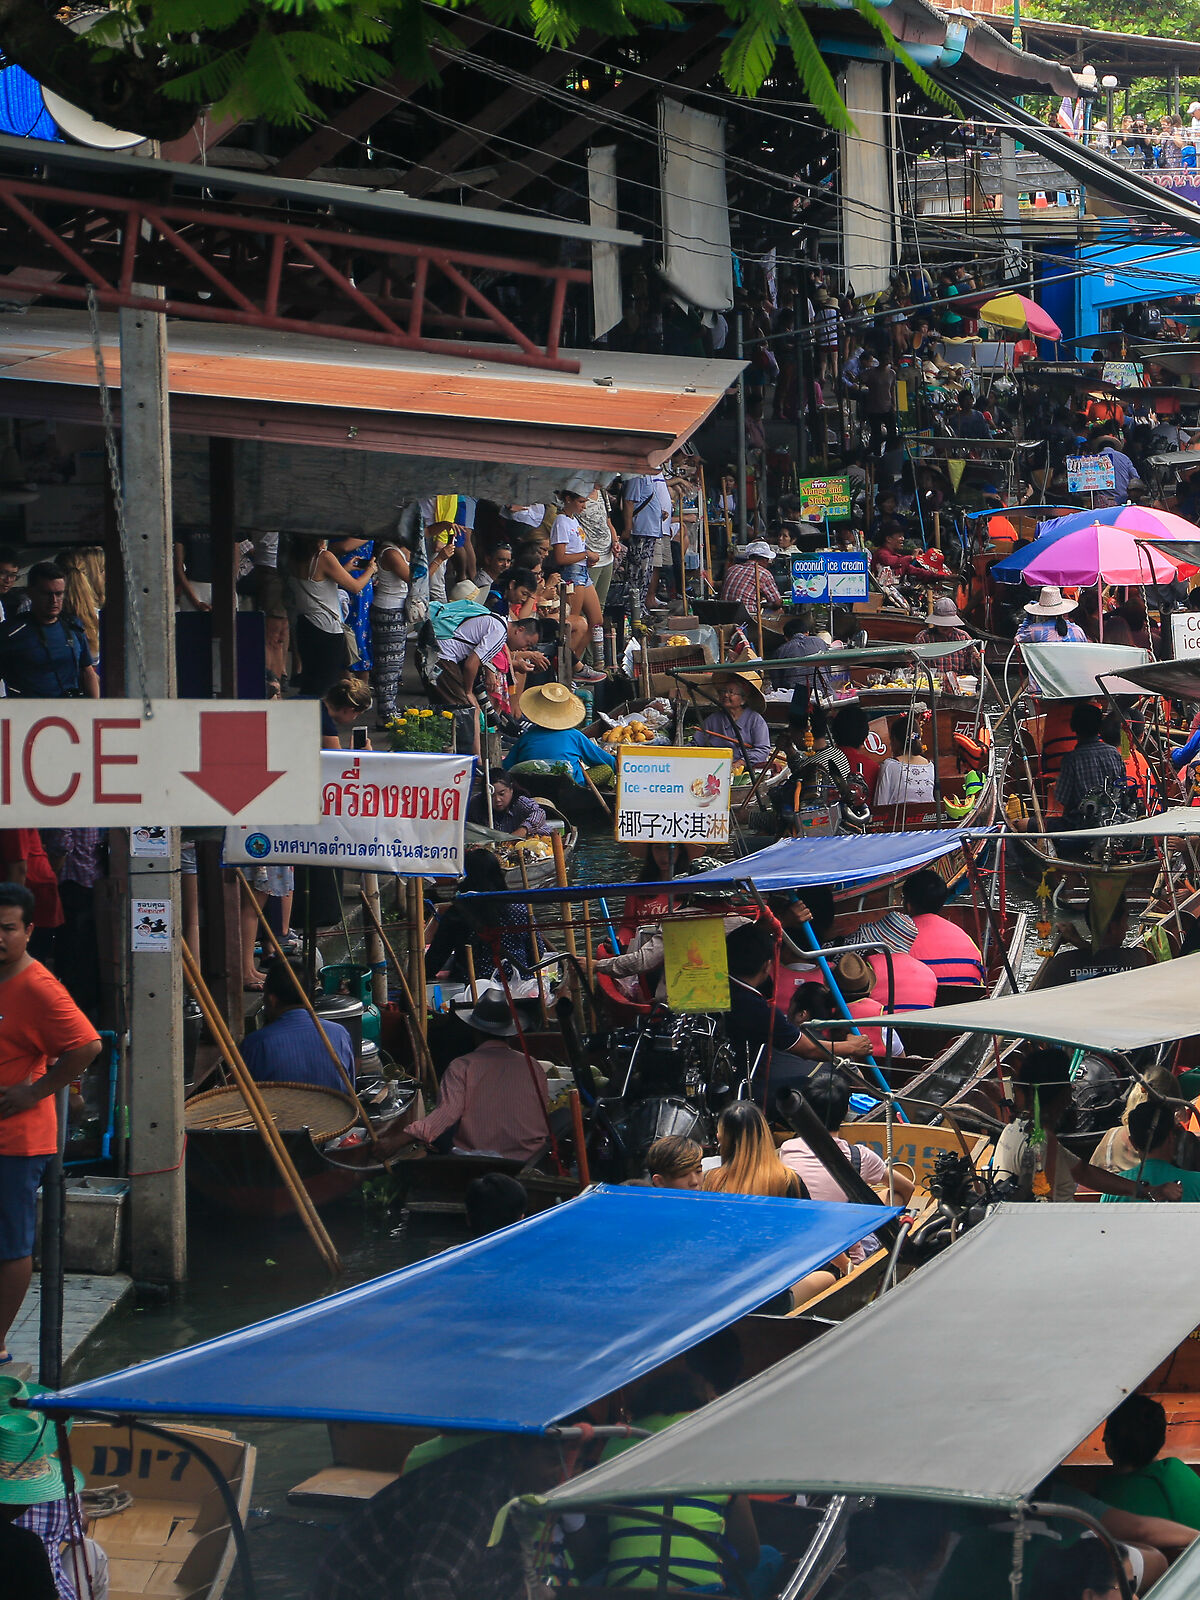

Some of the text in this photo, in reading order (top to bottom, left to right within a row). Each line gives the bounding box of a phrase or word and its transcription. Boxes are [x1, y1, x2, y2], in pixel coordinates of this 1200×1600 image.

[802, 487, 827, 496] Mango
[829, 484, 843, 494] and
[808, 494, 849, 507] Sticky Rice
[795, 557, 864, 571] coconut ice cream
[1, 716, 142, 807] ICE
[623, 762, 671, 773] Coconut
[624, 782, 640, 793] Ice
[618, 810, 729, 839] 椰子冰淇淋
[273, 836, 458, 860] เทศบาลตำบลดำเนินสะดวก
[1070, 968, 1098, 977] EDDIE
